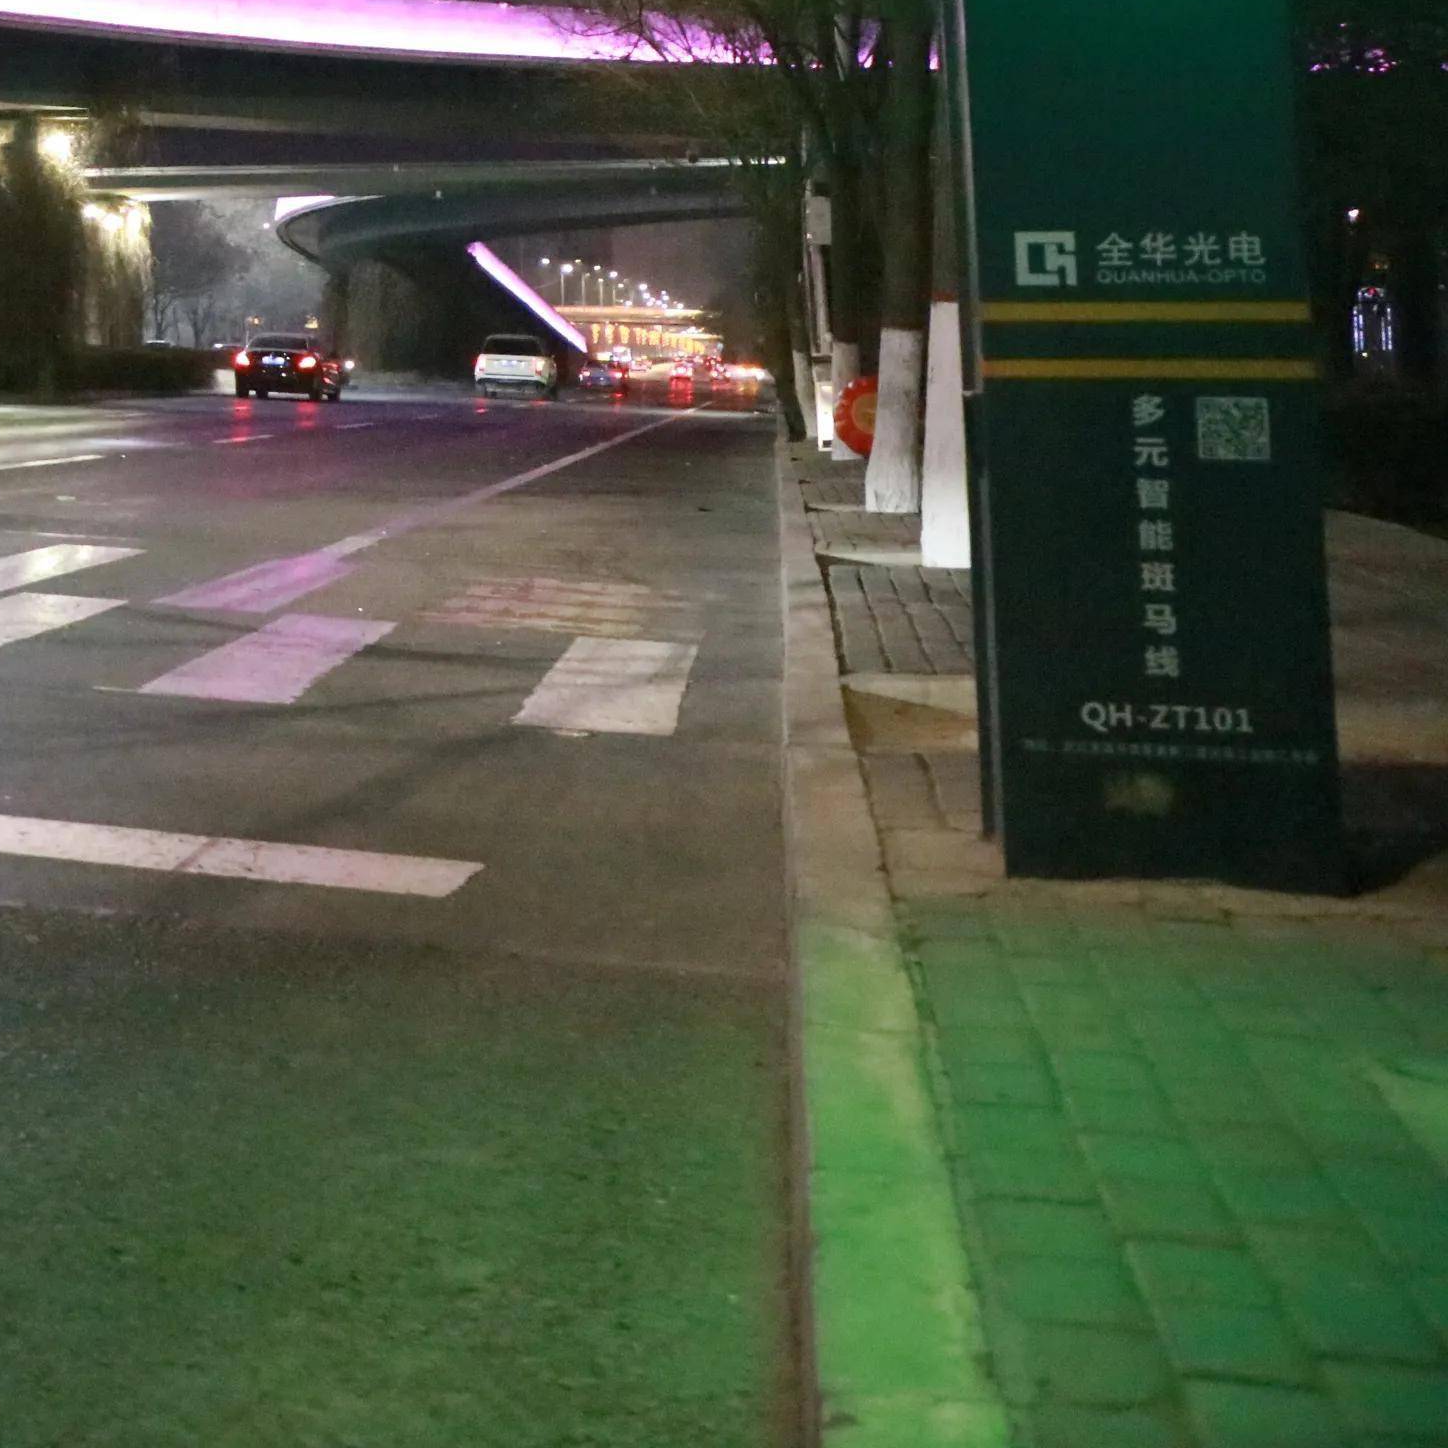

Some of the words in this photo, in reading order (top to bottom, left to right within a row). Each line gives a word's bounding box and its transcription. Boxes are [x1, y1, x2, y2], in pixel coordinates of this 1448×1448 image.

[1096, 230, 1268, 267] 全华光电
[1132, 393, 1181, 679] 多元智能斑马线
[1080, 701, 1255, 734] QH-ZT101
